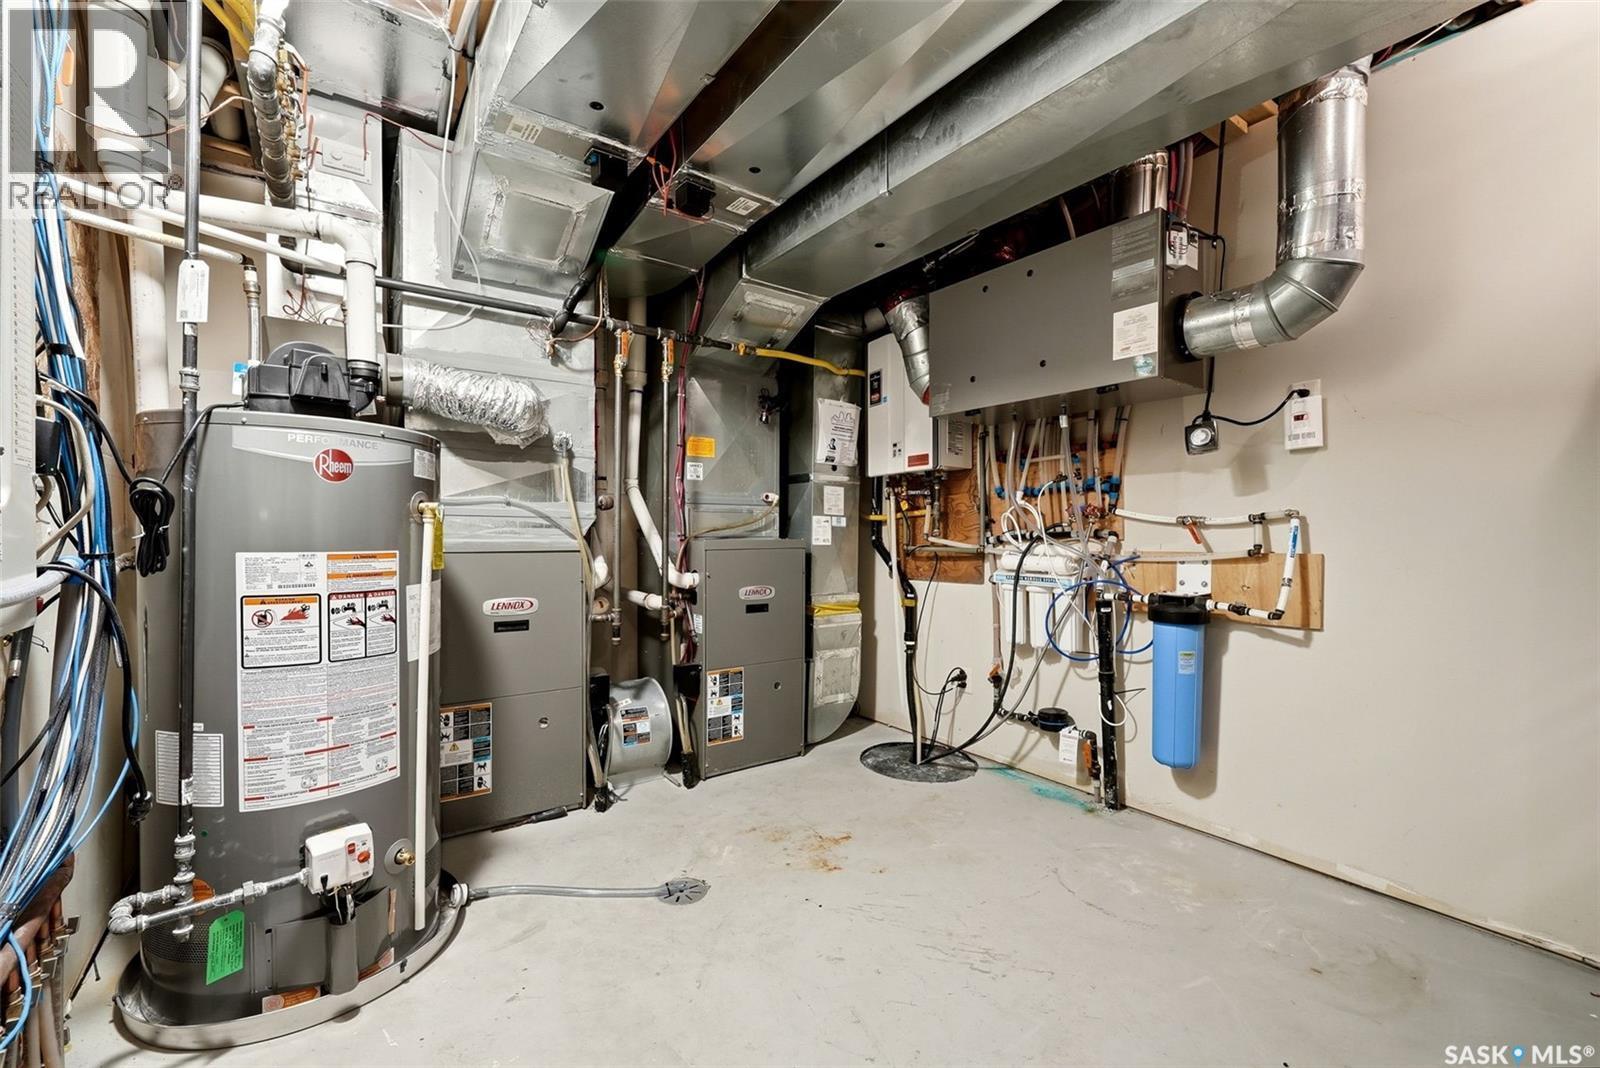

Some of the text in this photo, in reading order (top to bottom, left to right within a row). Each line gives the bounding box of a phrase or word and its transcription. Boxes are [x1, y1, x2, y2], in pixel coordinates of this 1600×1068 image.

[287, 433, 379, 450] PERFOMANCE
[319, 448, 352, 477] Rheem
[491, 601, 525, 610] LENNOX
